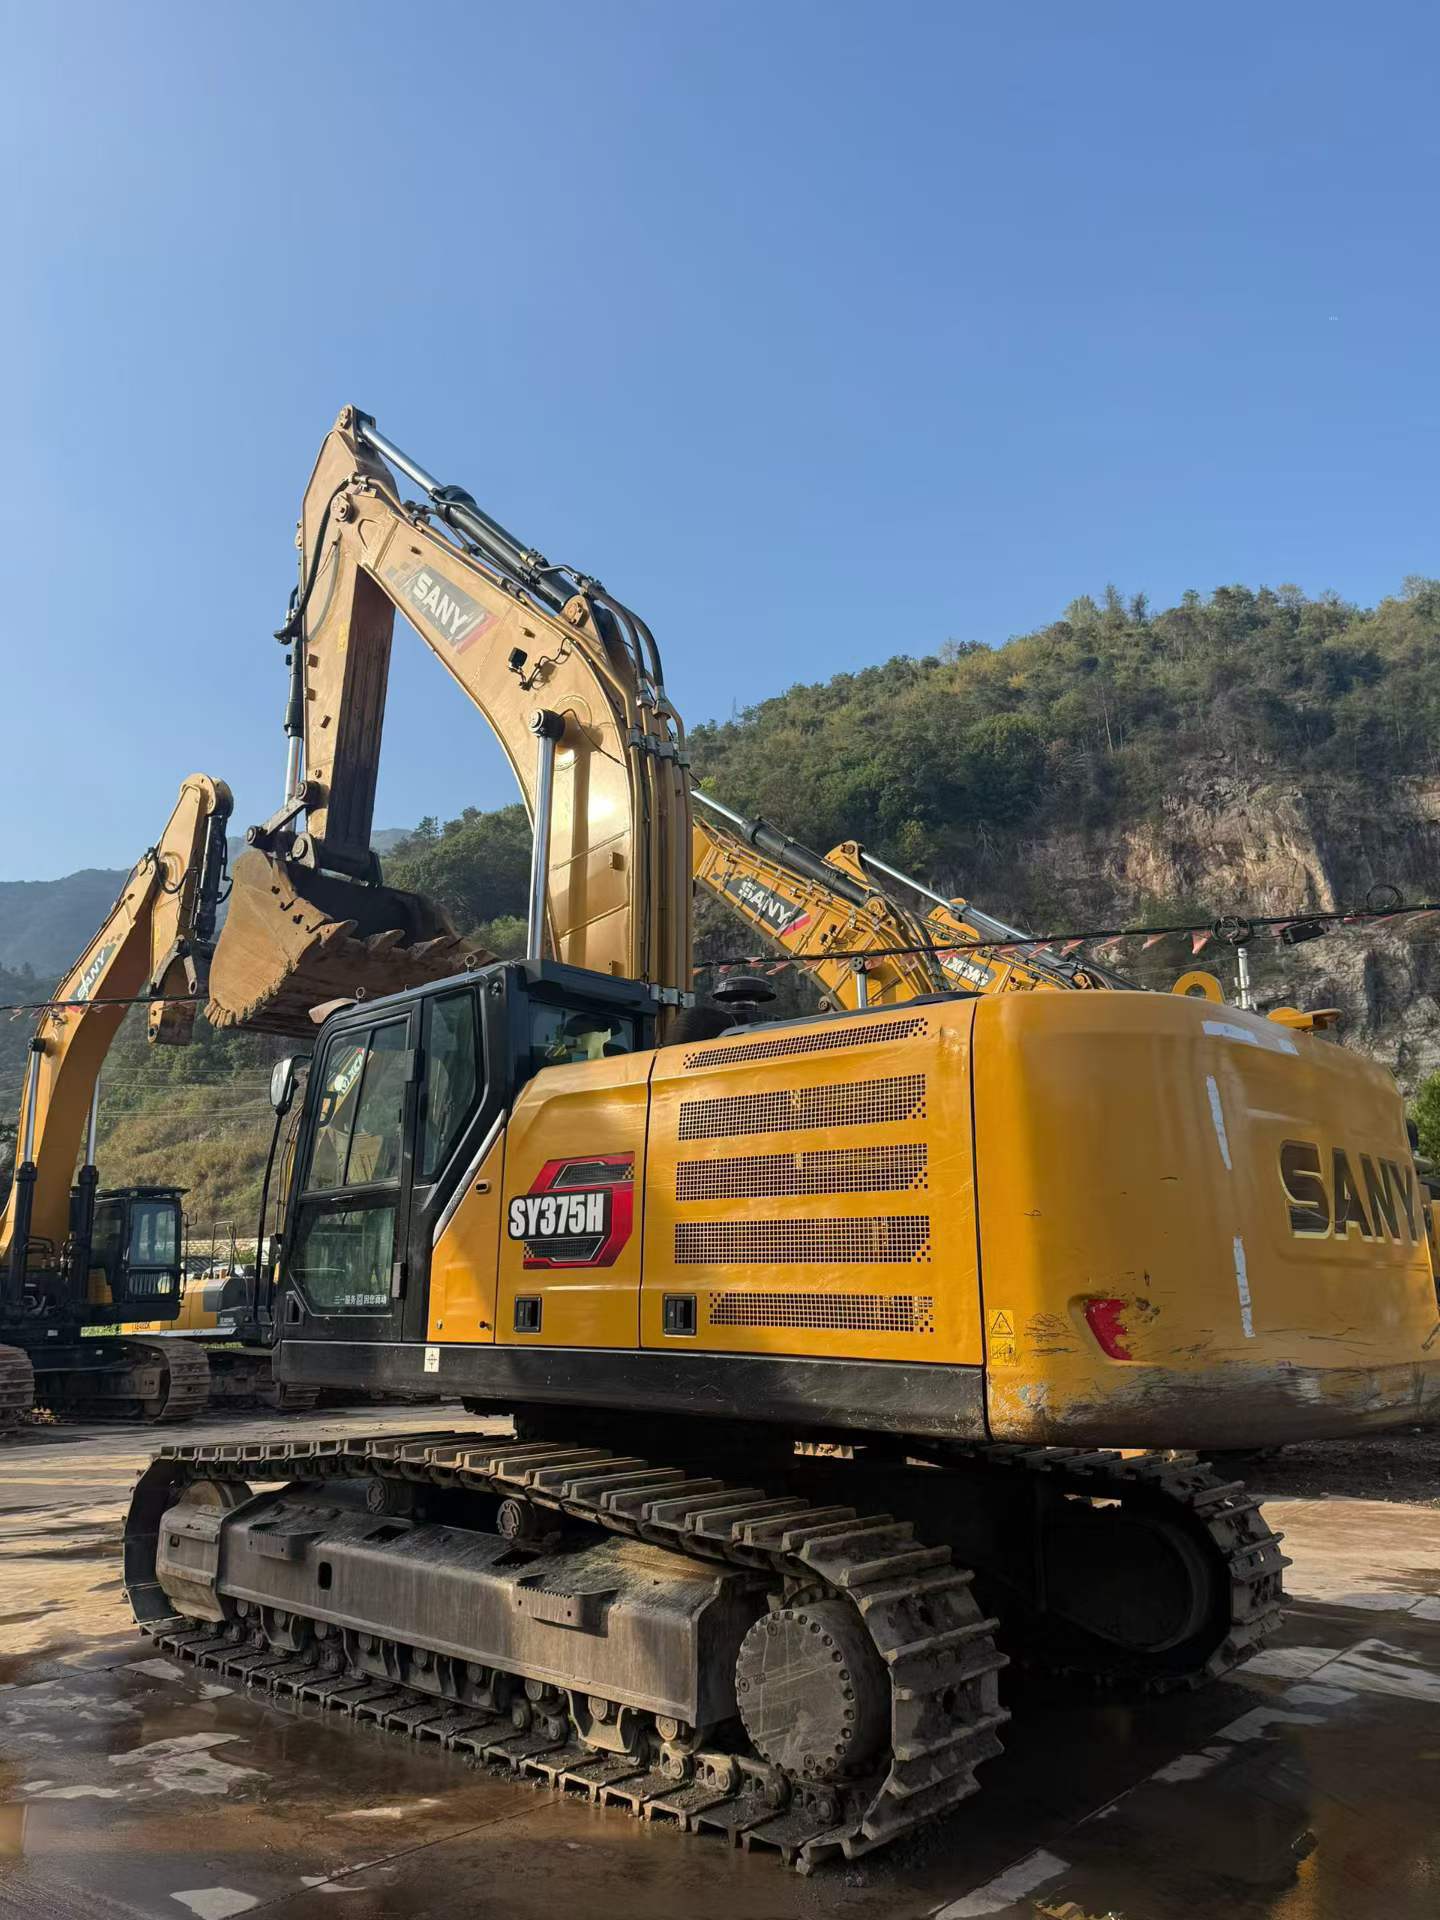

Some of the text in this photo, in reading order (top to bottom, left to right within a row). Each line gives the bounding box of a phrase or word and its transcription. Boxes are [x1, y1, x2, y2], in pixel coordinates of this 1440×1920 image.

[412, 572, 469, 634] SANY
[737, 880, 793, 924] SANY
[76, 949, 105, 1000] SANY
[510, 1193, 604, 1237] SY375H
[1277, 1138, 1420, 1247] SANY
